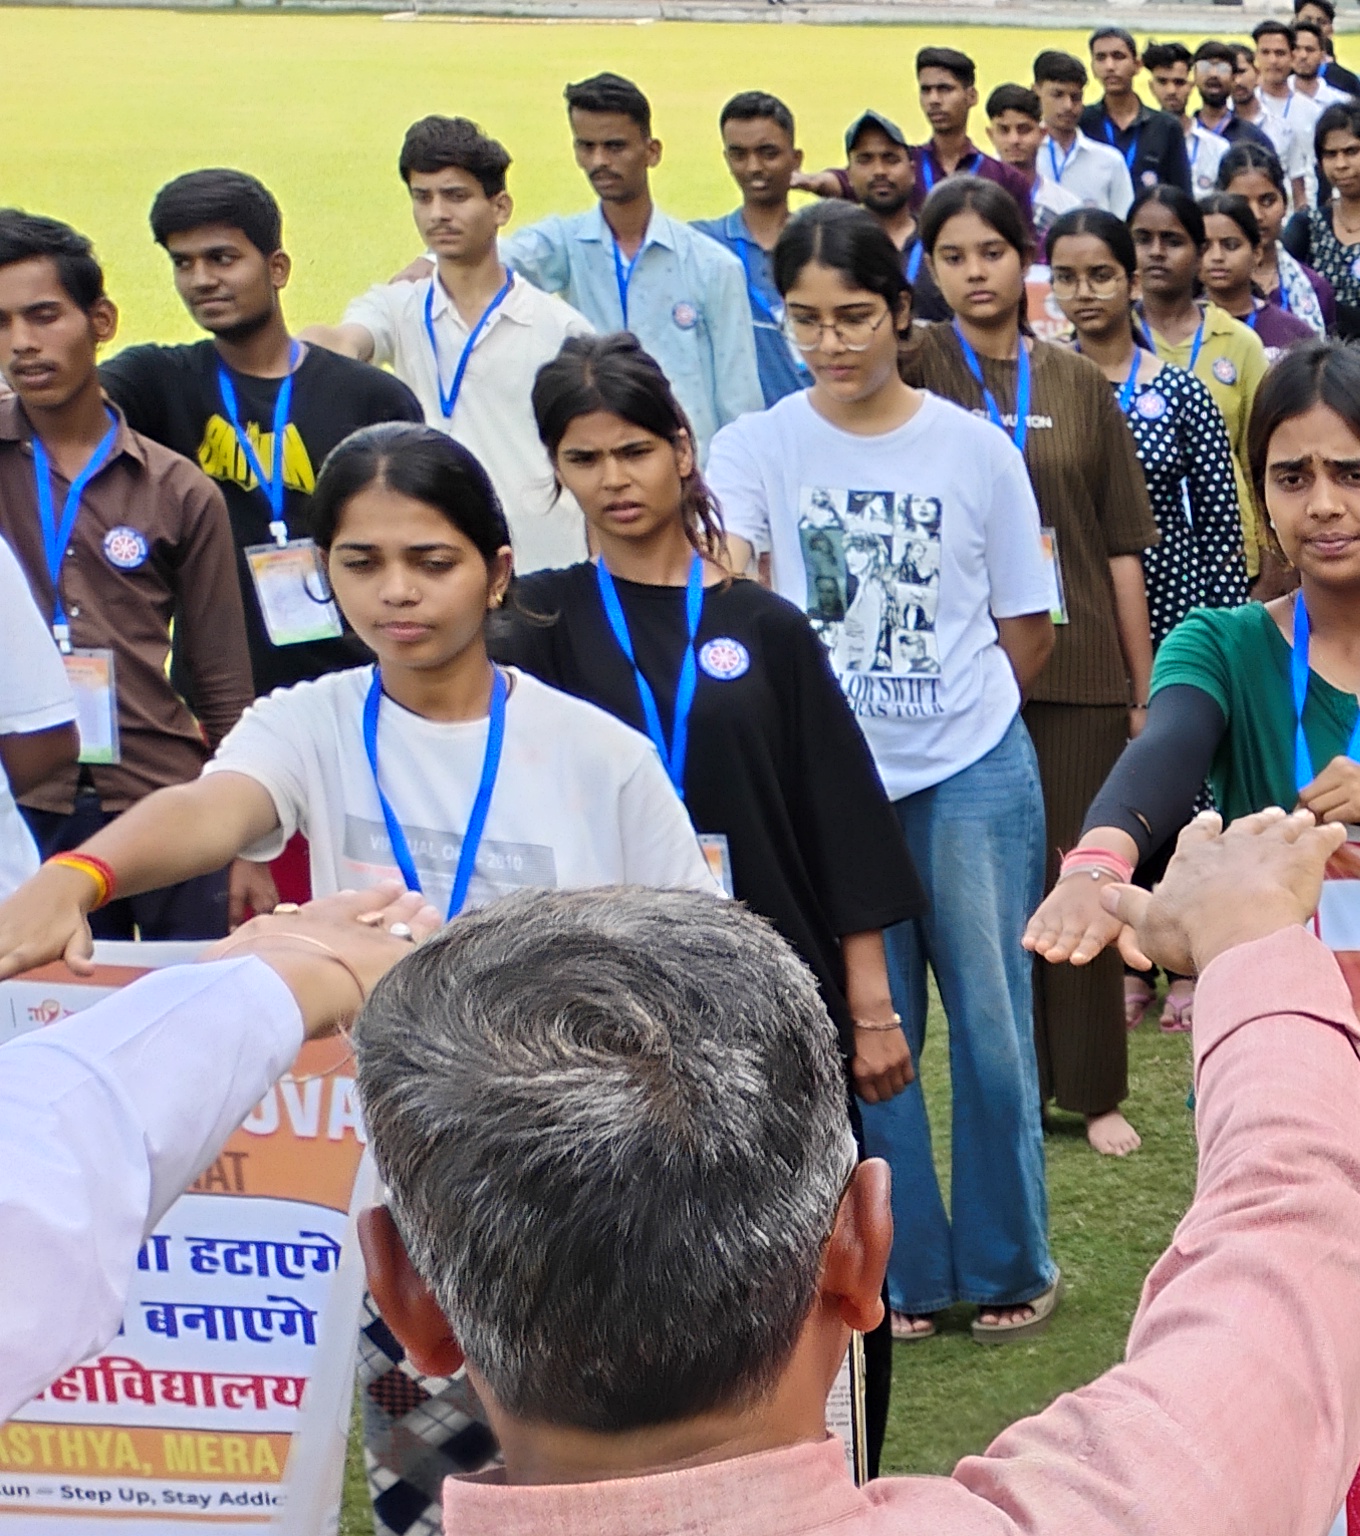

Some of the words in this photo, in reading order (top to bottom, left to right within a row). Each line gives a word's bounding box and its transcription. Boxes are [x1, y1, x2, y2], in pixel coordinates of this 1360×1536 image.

[193, 1152, 249, 1192] AT
[32, 1355, 311, 1411] हाविद्यालय
[162, 1433, 280, 1478] MERA
[60, 1484, 112, 1505] Step
[162, 1489, 211, 1510] Stay
[219, 1490, 287, 1507] Addic
